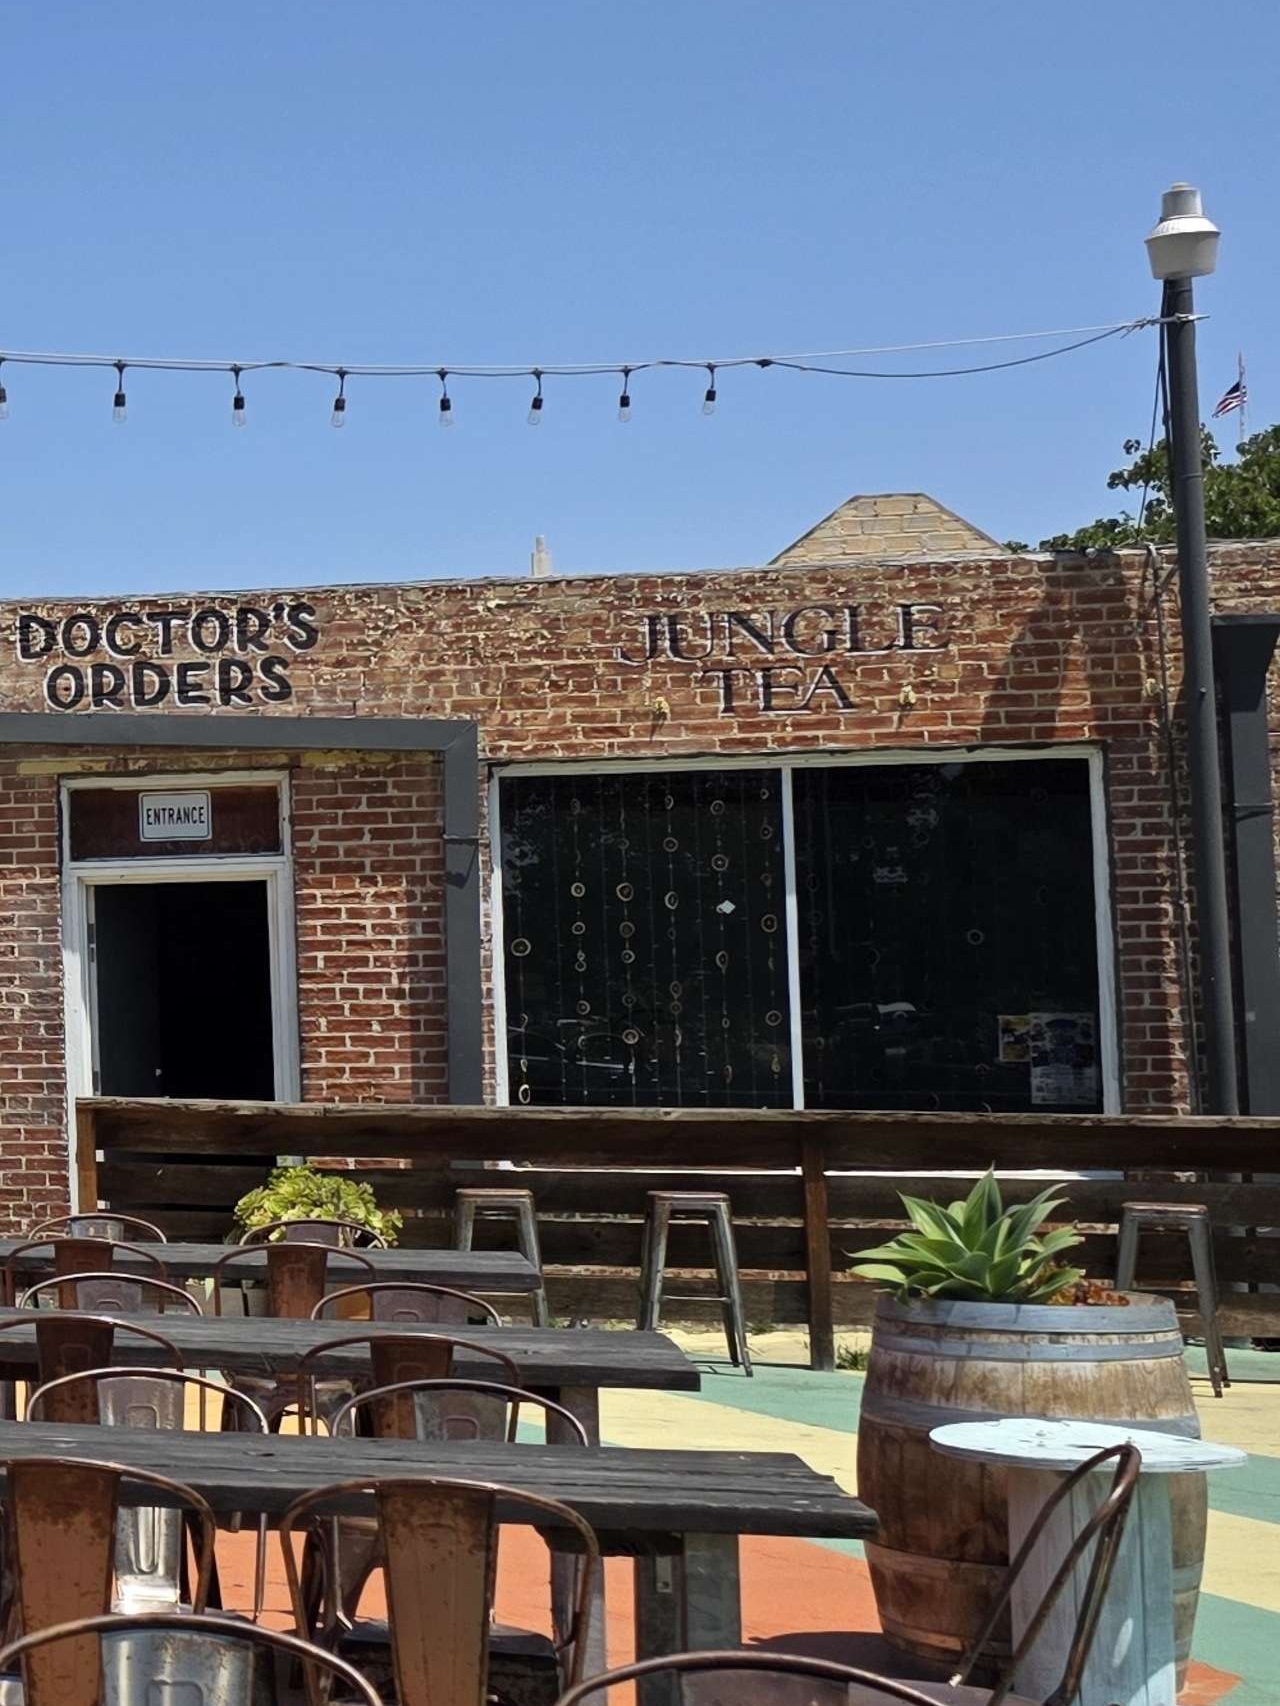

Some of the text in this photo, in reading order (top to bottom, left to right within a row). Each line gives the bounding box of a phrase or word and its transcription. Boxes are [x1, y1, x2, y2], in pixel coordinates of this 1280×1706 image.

[16, 601, 319, 662] DOCTOR'S
[613, 602, 949, 667] JUNGLE
[44, 656, 293, 711] ORDERS
[696, 664, 859, 717] TEA
[146, 806, 205, 826] ENTRANCE
